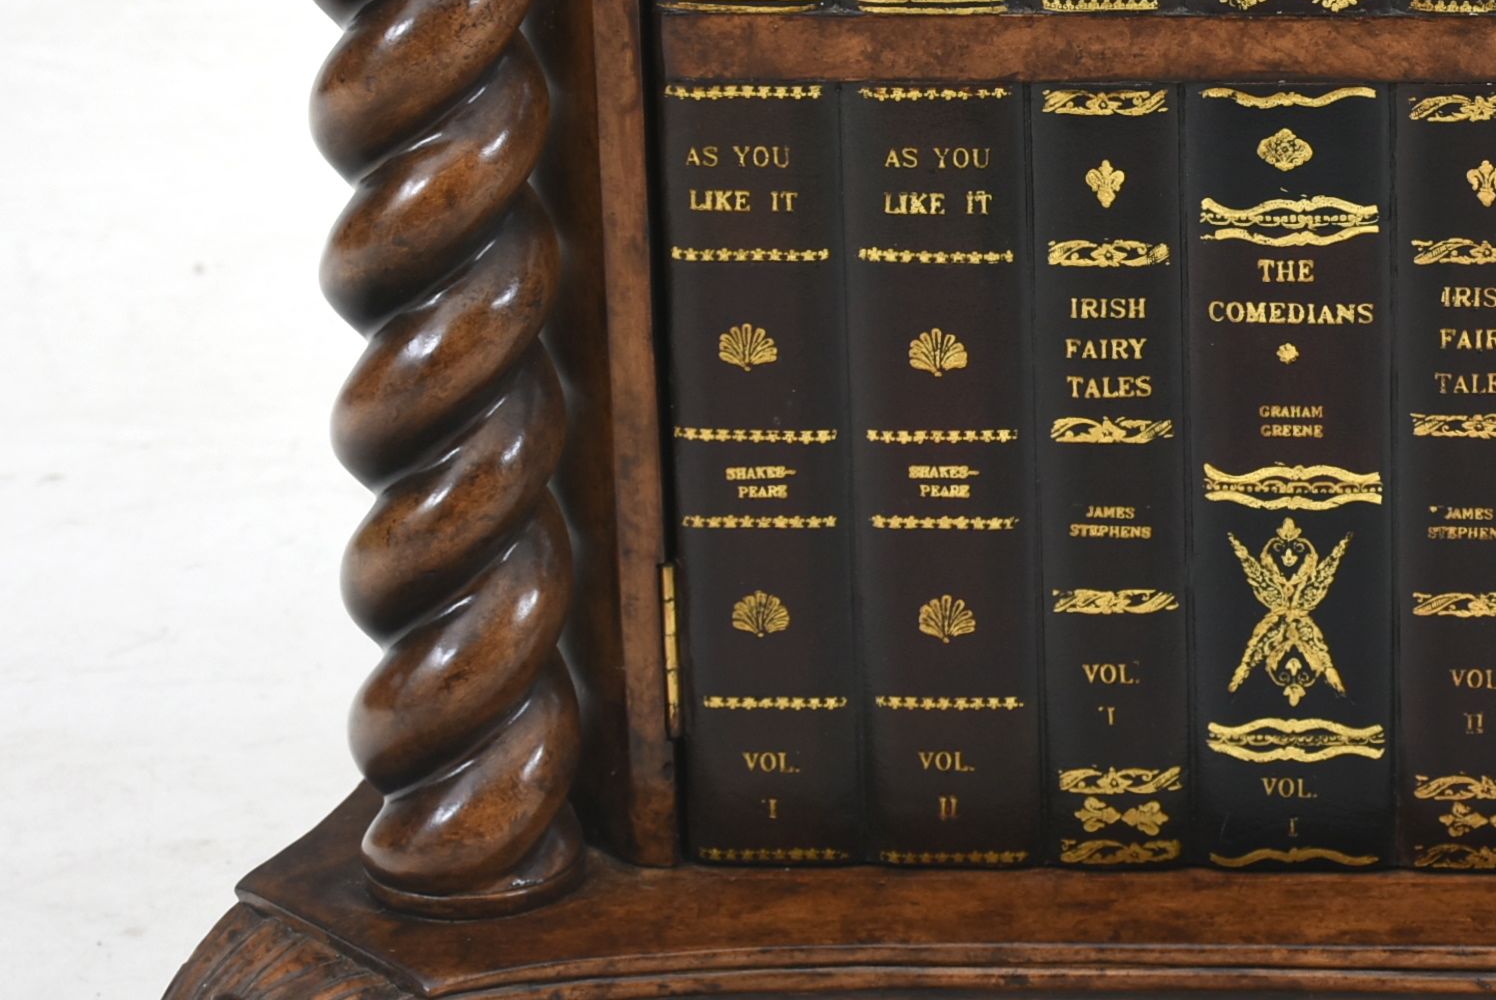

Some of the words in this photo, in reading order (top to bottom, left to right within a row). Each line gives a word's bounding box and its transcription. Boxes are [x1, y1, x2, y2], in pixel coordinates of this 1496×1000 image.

[685, 147, 718, 167] AS
[733, 146, 790, 168] YOU
[884, 148, 918, 168] AS
[933, 147, 990, 169] YOU
[689, 190, 750, 212] LIKE
[771, 190, 798, 212] IT
[884, 191, 945, 215] LIKE
[966, 190, 993, 215] IT
[1258, 259, 1314, 283] THE
[1070, 297, 1147, 319] IRISH
[1209, 301, 1373, 325] COMEDIANS
[1065, 339, 1147, 360] FAIRY
[1066, 376, 1152, 399] TALES
[1259, 405, 1323, 419] GRAHAM
[1261, 424, 1323, 438] GREENE
[738, 485, 788, 498] PEARE
[920, 485, 970, 498] PEARE
[1085, 506, 1135, 521] JAMES
[1445, 506, 1493, 522] JAMES
[1069, 524, 1151, 540] STEPHENS
[1082, 663, 1140, 685] VOL.
[1106, 706, 1115, 727] I
[1466, 712, 1484, 735] II
[742, 751, 801, 773] VOL.
[919, 751, 975, 772] VOL.
[1263, 777, 1318, 800] VOL.
[768, 799, 777, 818] I
[938, 796, 957, 820] II
[1289, 817, 1297, 838] I
